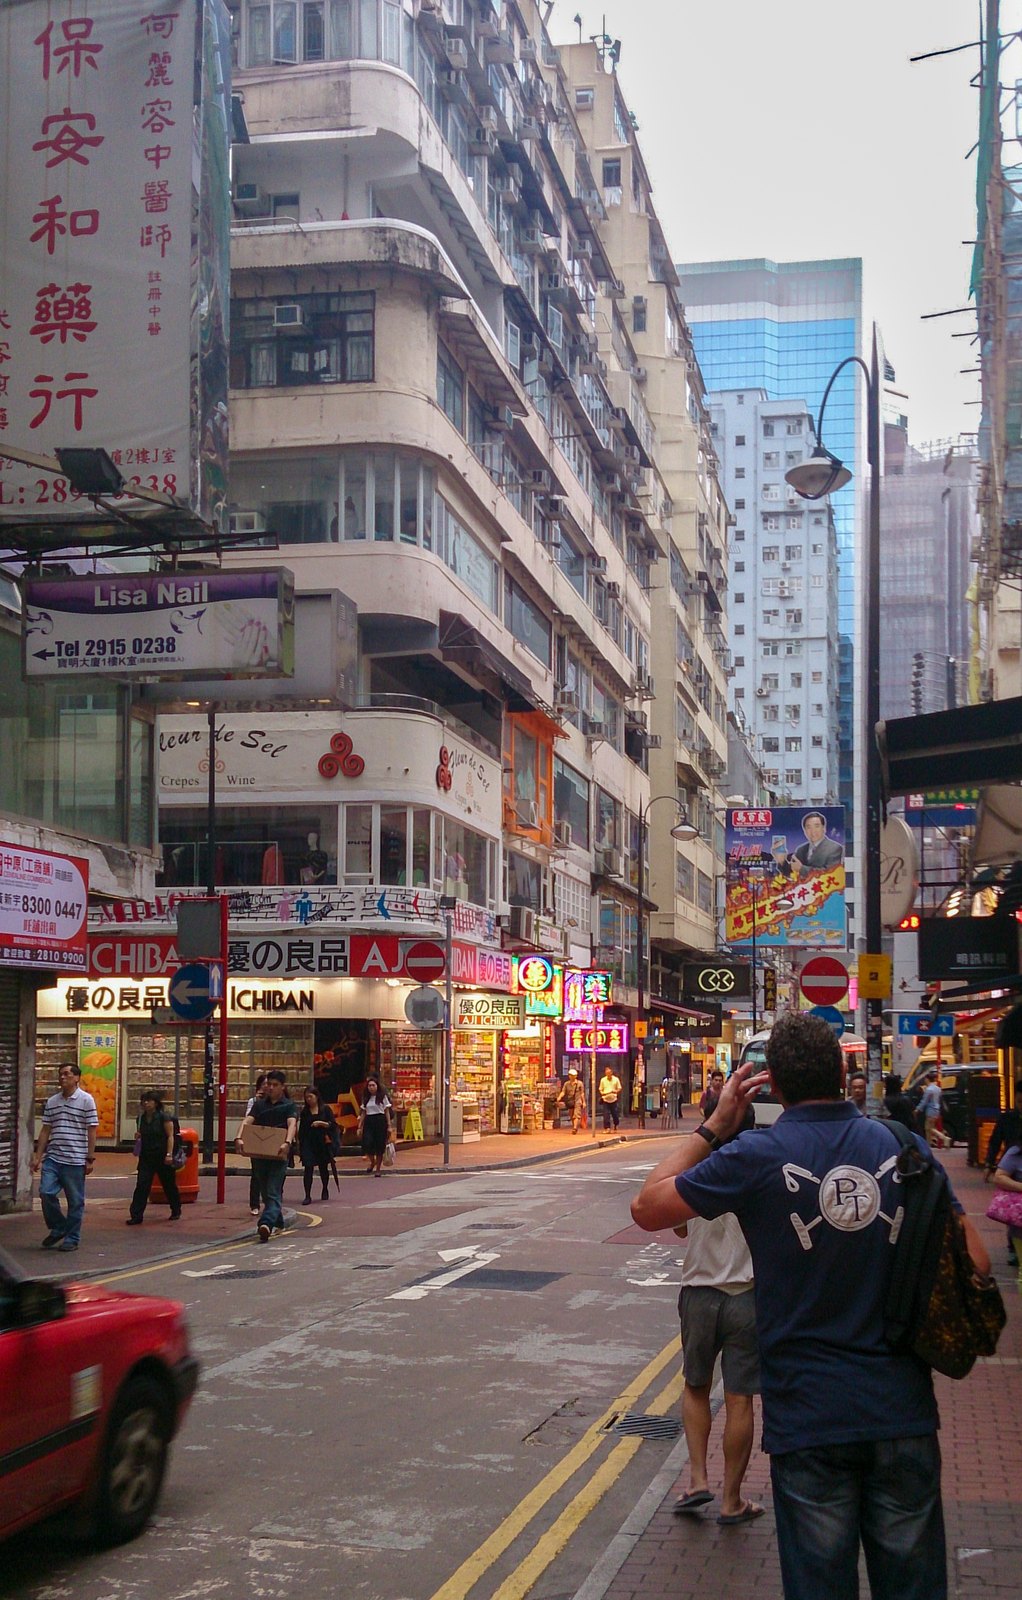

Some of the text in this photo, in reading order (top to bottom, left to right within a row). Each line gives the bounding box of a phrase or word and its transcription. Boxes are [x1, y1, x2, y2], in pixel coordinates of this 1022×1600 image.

[140, 13, 179, 258] 何麗容中醫師
[30, 17, 104, 431] 保安和藥行
[147, 270, 162, 336] 註冊中醫
[94, 582, 208, 607] Lisa Nail
[55, 636, 176, 657] Tel 2915 0238
[240, 730, 288, 758] Sel
[161, 774, 256, 788] Crepes Wine
[22, 895, 51, 916] 8300
[55, 900, 82, 920] 0447
[37, 949, 60, 962] 2810
[63, 952, 84, 964] 9900
[65, 986, 166, 1012] 優の良品
[231, 986, 314, 1012] ICHIBAN
[460, 999, 520, 1015] 優の良品
[462, 1016, 518, 1025] AJI ICHIBAN
